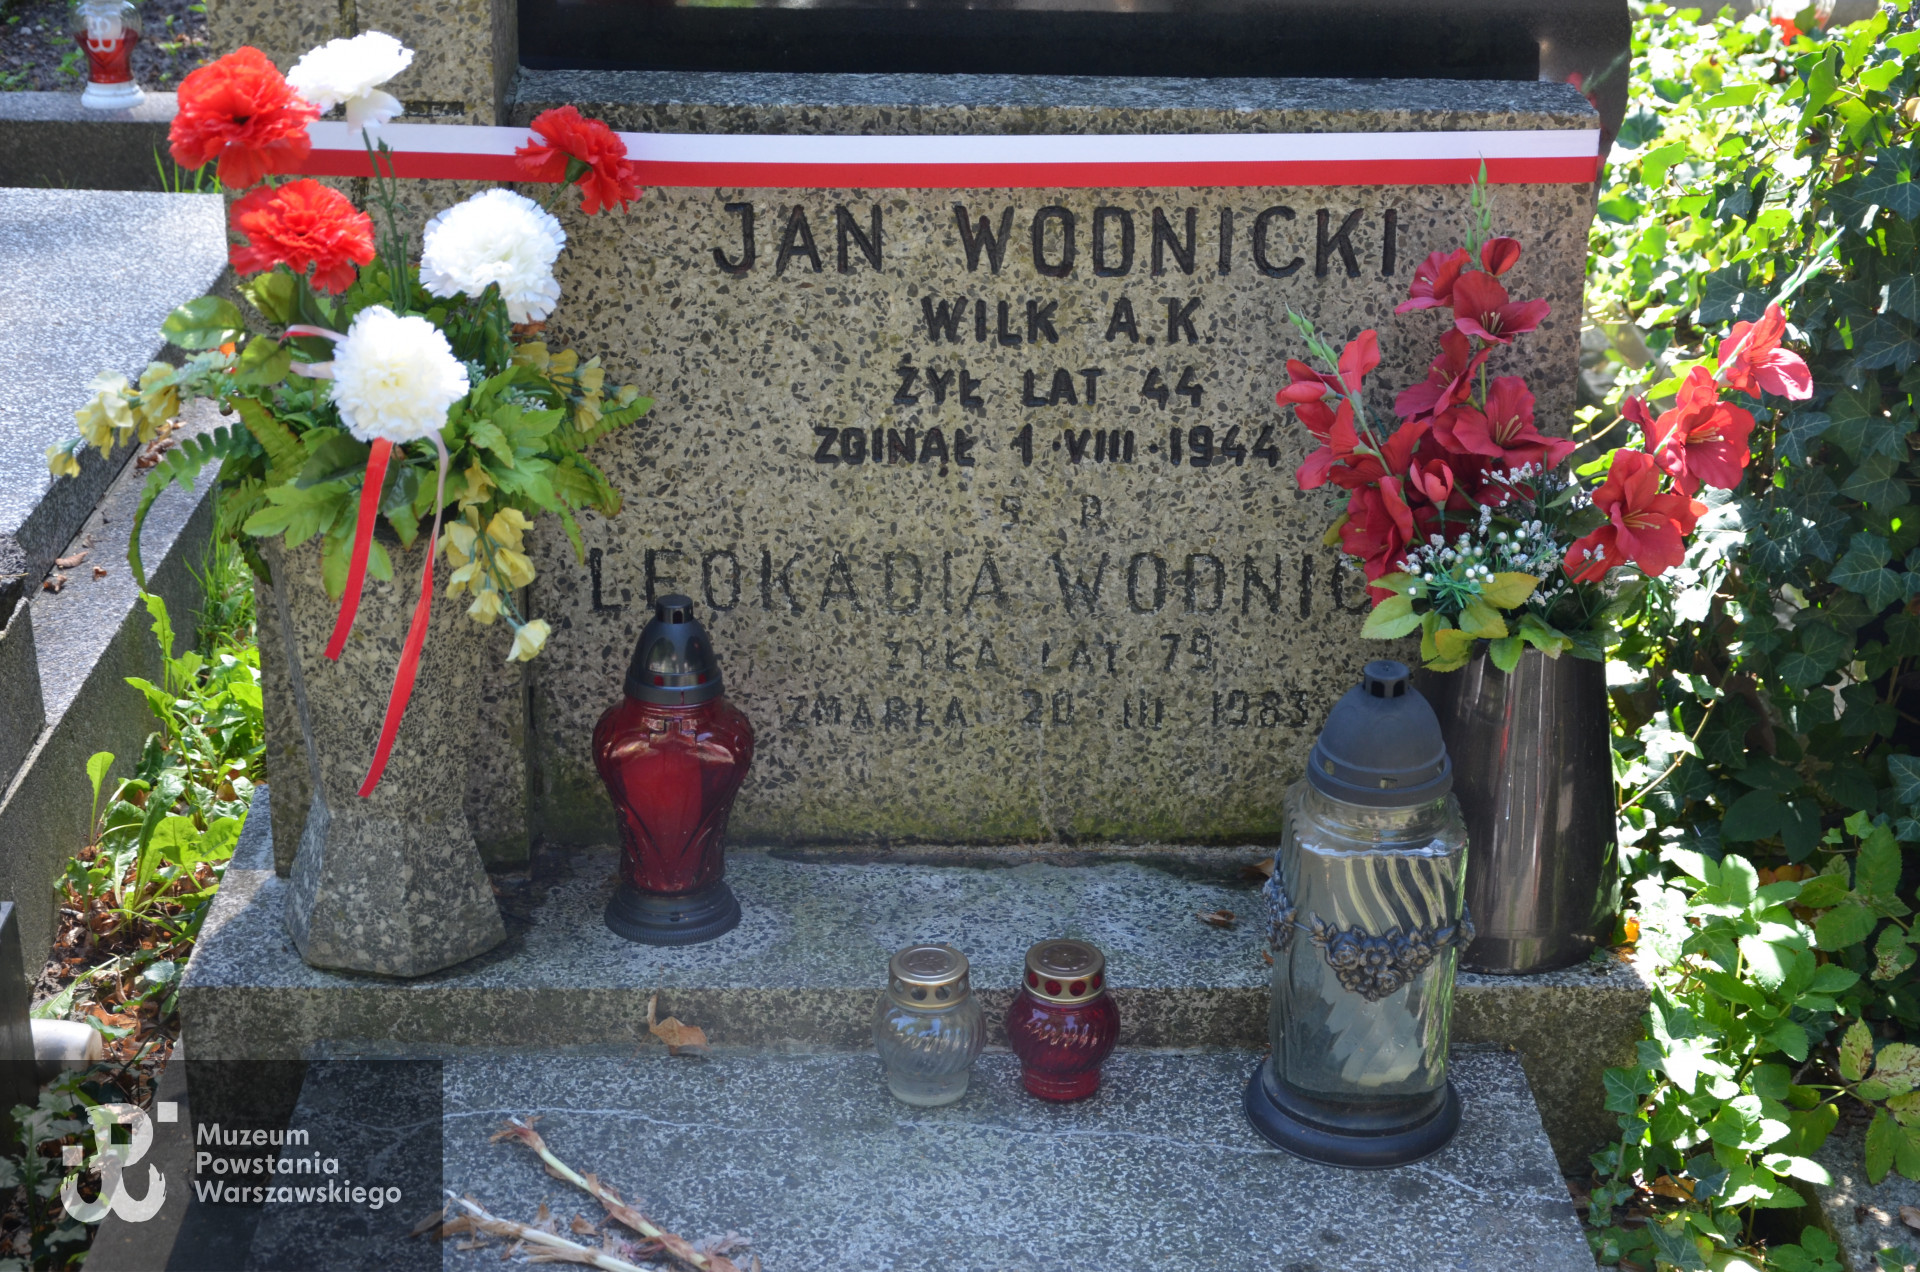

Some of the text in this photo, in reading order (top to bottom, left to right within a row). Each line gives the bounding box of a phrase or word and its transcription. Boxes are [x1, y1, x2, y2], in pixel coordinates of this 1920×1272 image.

[713, 202, 1398, 279] JAN WODNICKI
[921, 295, 1059, 345] WILK
[1022, 366, 1104, 408] LAT
[1142, 364, 1205, 411] 44
[813, 426, 976, 468] ZGINAŁ
[589, 546, 1374, 620] LEOKADIA WODNIC
[1041, 637, 1121, 674] LAT
[1022, 687, 1074, 729] 20
